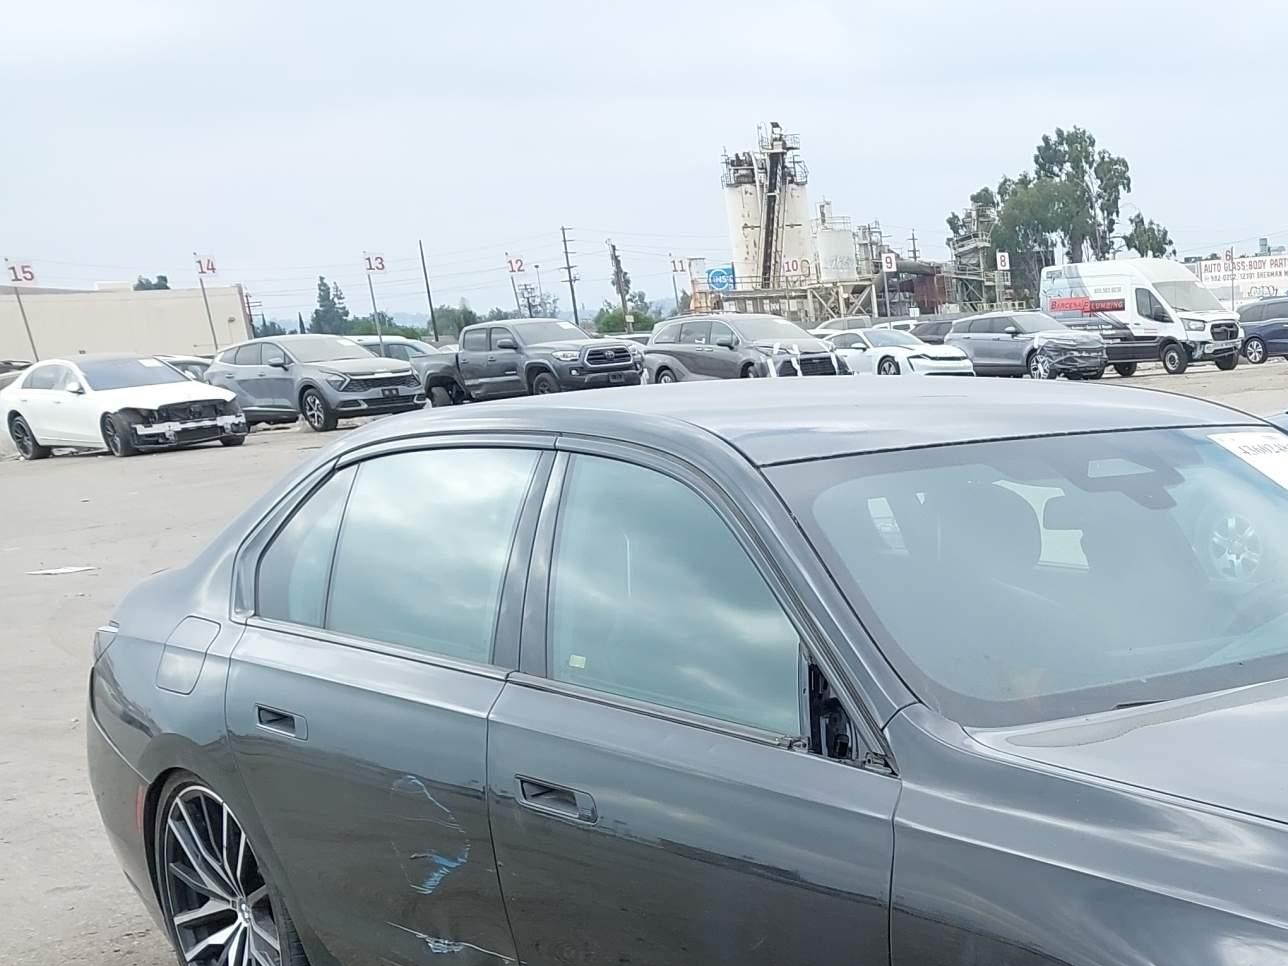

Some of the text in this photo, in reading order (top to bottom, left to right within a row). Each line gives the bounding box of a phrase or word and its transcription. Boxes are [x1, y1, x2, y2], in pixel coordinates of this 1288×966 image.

[885, 255, 893, 269] 9
[1000, 256, 1006, 267] 8
[1225, 250, 1231, 261] 6
[196, 259, 216, 274] 14
[365, 256, 385, 271] 13
[508, 259, 525, 273] 12
[671, 260, 686, 272] 11
[784, 260, 798, 273] 10
[1204, 262, 1221, 273] AUTO
[8, 265, 34, 282] 15
[1257, 271, 1282, 279] SHERMAN
